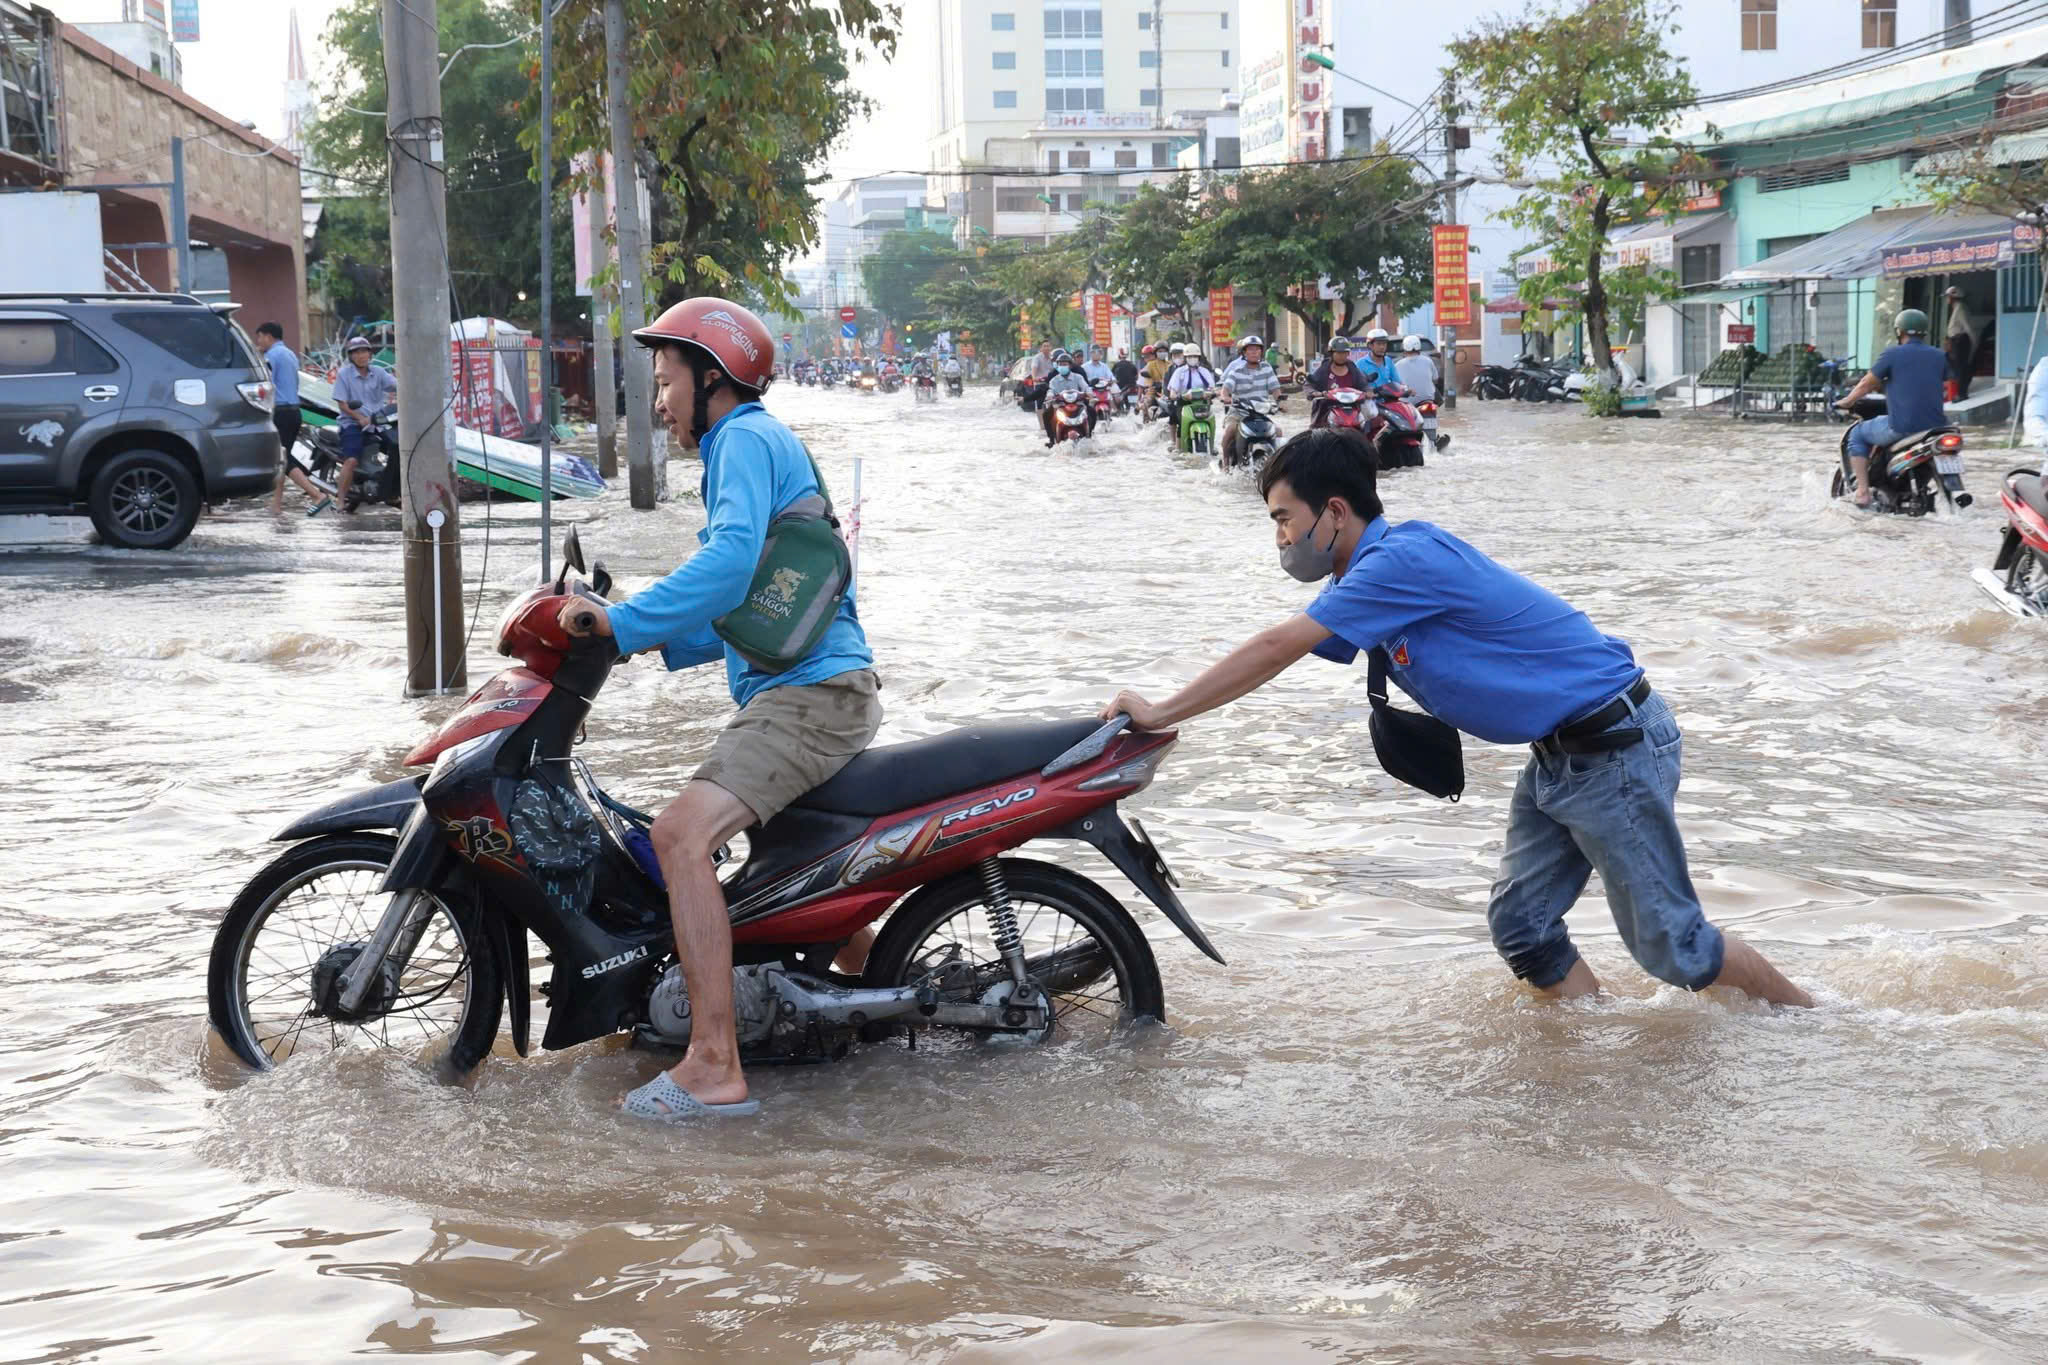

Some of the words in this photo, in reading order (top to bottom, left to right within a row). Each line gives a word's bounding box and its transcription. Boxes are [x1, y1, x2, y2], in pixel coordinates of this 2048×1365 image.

[751, 592, 793, 617] SAIGON
[752, 602, 780, 620] SPECIAL
[941, 787, 1037, 828] REVO
[581, 945, 649, 980] SUZUKI
